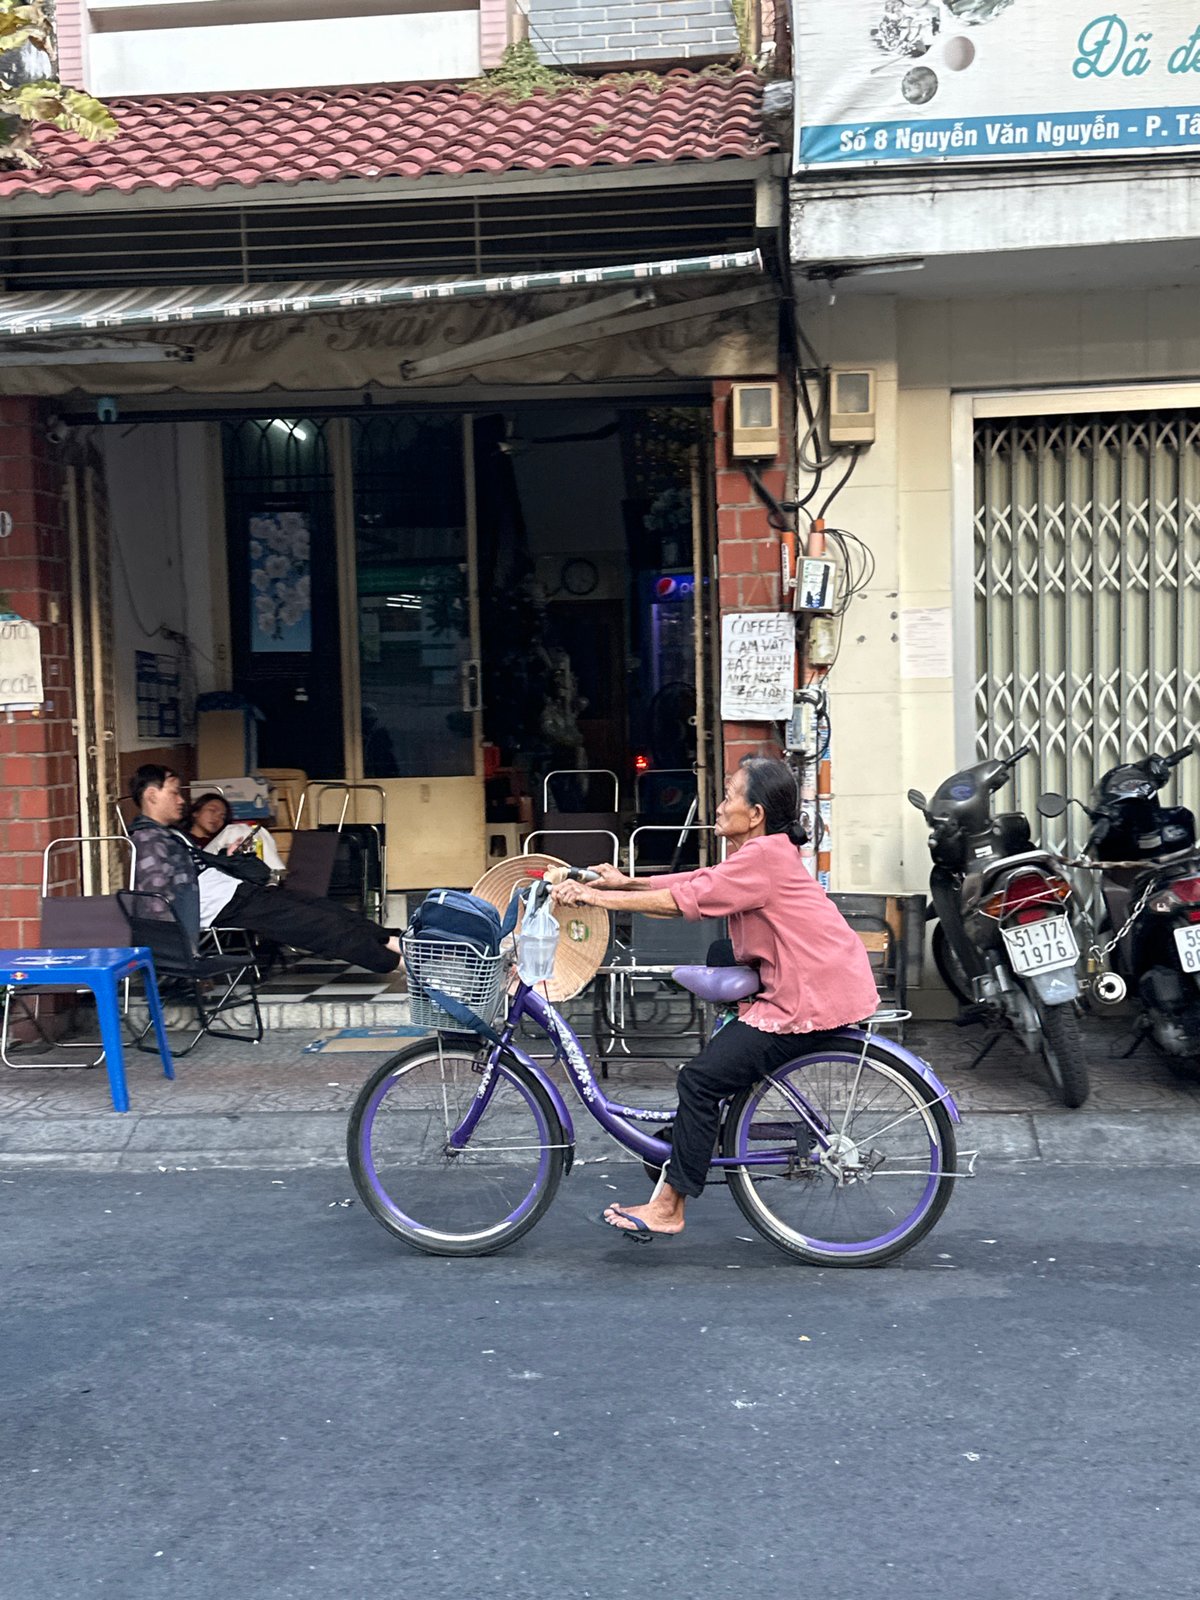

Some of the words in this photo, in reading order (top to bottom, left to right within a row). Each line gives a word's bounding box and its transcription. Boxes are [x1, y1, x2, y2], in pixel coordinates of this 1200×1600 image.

[1072, 14, 1153, 79] Đã
[840, 127, 870, 152] Số
[874, 129, 888, 150] 8
[895, 122, 977, 153] Nguyễn
[985, 123, 1029, 145] Văn
[1036, 115, 1120, 147] Nguyễn
[1145, 115, 1168, 137] P.
[731, 620, 785, 634] COFFEE
[1020, 940, 1067, 967] 1976
